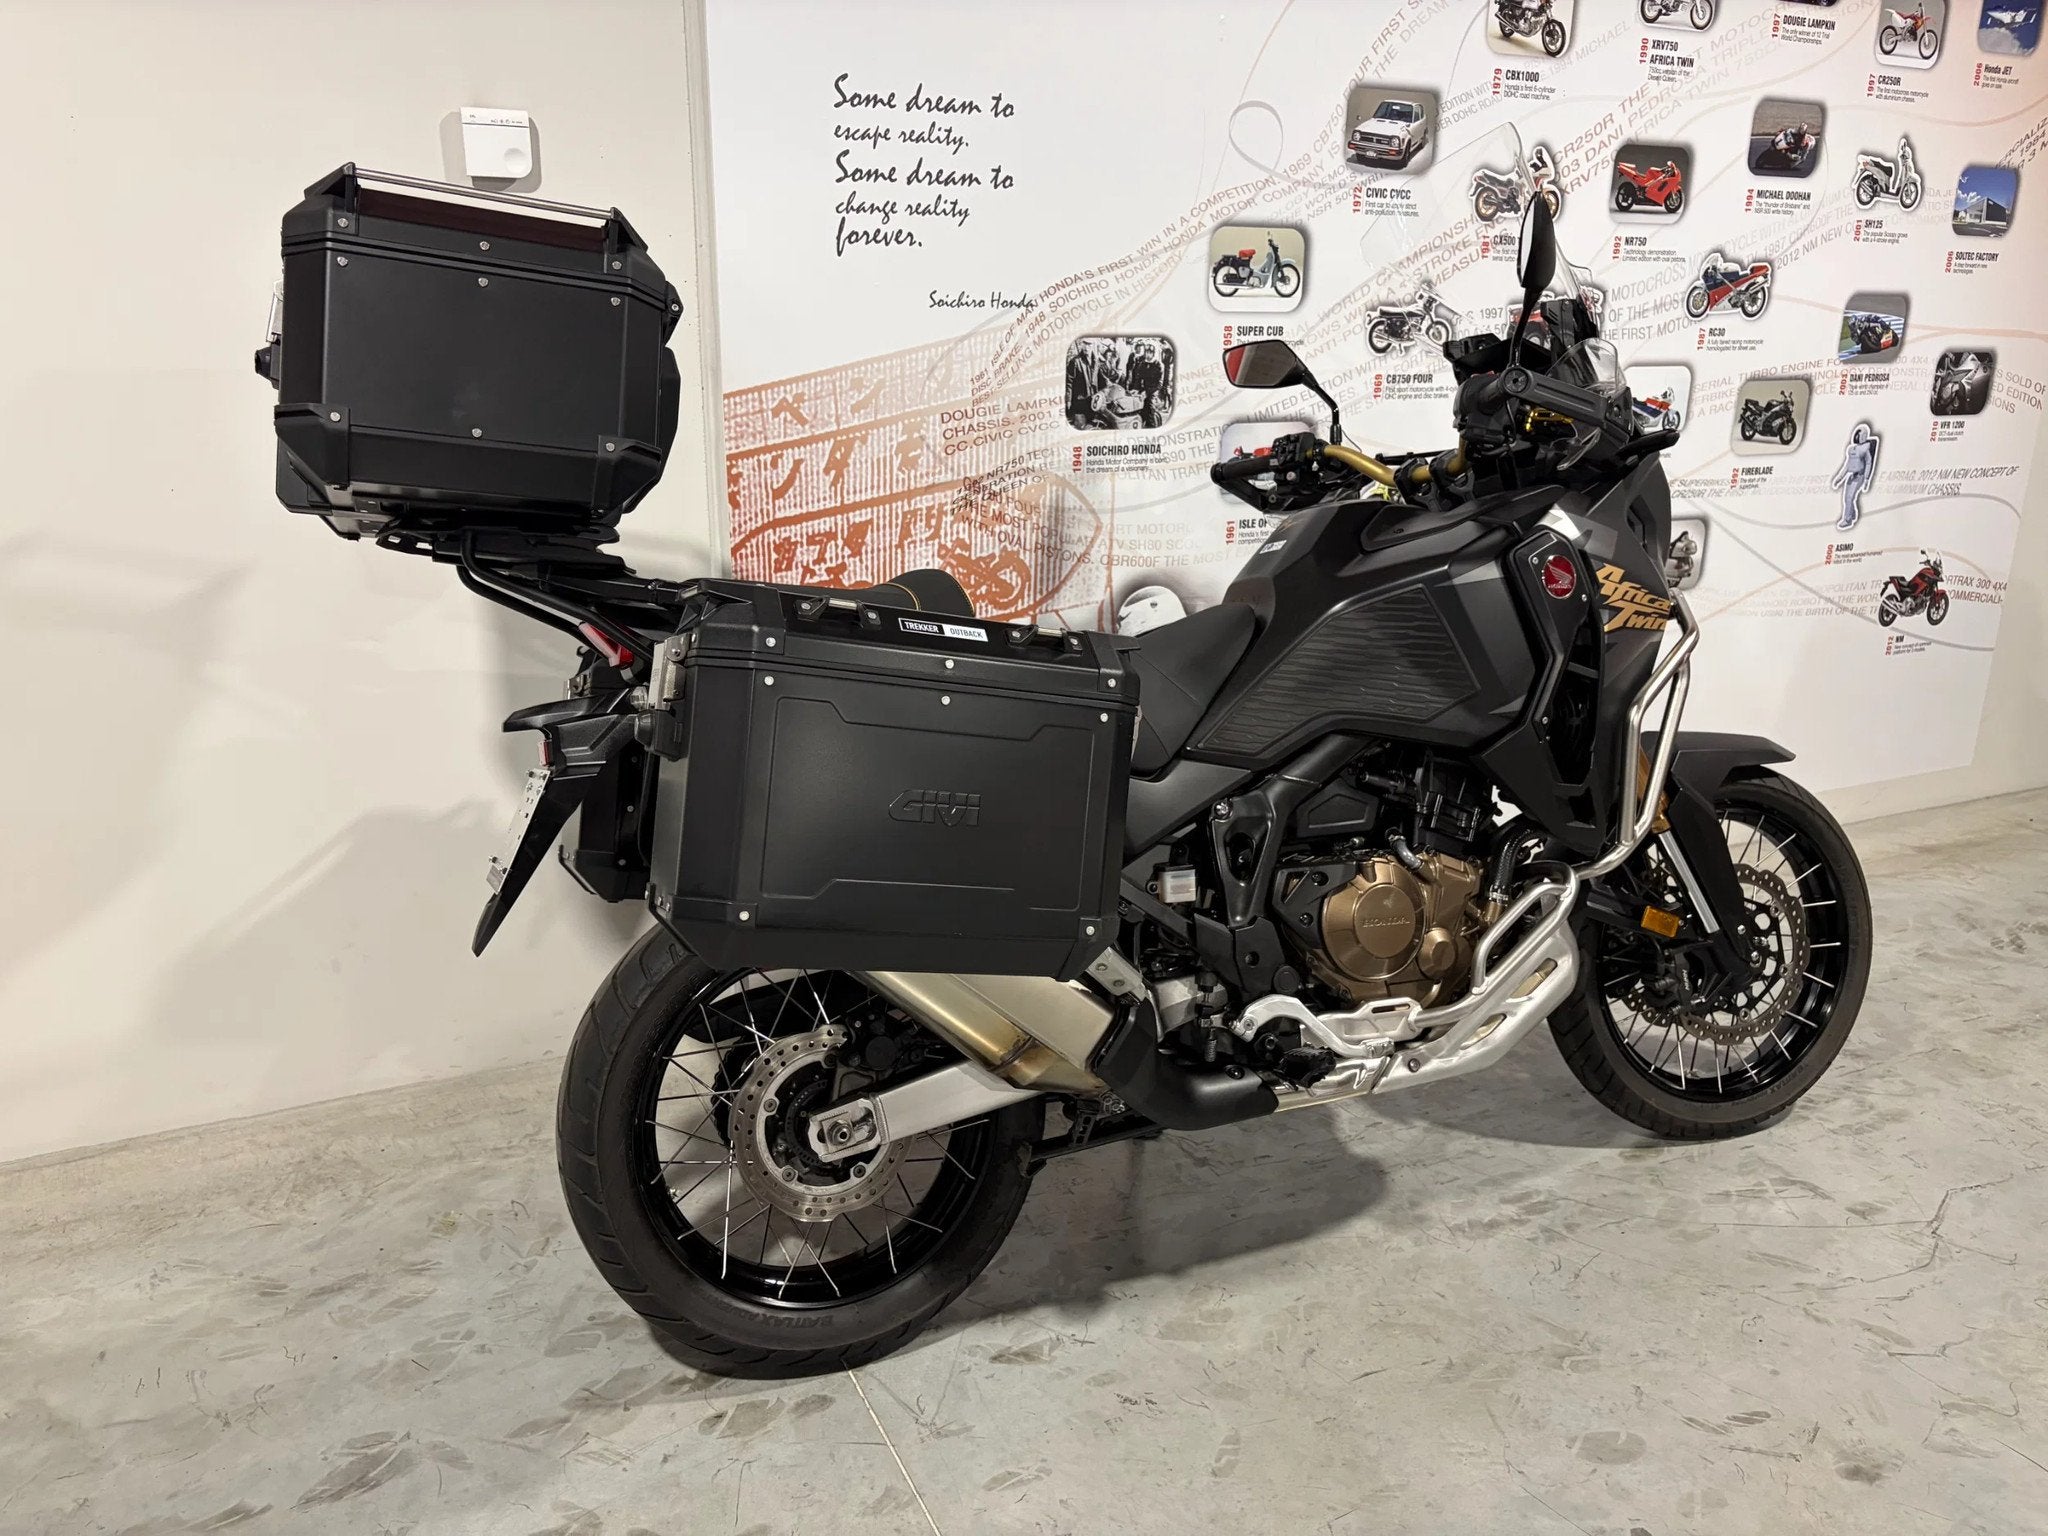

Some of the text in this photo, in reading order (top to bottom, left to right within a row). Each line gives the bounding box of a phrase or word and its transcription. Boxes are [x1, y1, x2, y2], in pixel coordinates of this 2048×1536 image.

[1772, 13, 1780, 38] 1997
[1783, 15, 1836, 30] DOUGIE LAMPKIN
[1576, 20, 1630, 60] MICHAEL
[1651, 39, 1679, 52] XRV750
[1639, 38, 1649, 64] 1990
[1650, 54, 1694, 68] AFRICA TWIN
[1372, 44, 1400, 81] THE
[1984, 64, 2012, 75] Honda JET
[1492, 68, 1502, 95] 1979
[1506, 70, 1539, 82] CBX1000
[1878, 75, 1901, 86] CR250R
[1974, 63, 1982, 86] 2006
[834, 73, 1015, 118] Some dream to
[1867, 74, 1876, 97] 1997
[1440, 86, 1474, 114] EDITION
[1453, 103, 1478, 124] DOHC
[1552, 82, 1652, 165] CR250R THE
[834, 121, 969, 155] escape reality.
[1585, 124, 1624, 162] DANI
[835, 149, 1014, 189] Some dream to
[1005, 324, 1016, 344] OF
[1040, 270, 1095, 302] HONDA'S
[1097, 254, 1134, 276] FIRST
[1136, 235, 1162, 256] WIN
[1163, 223, 1177, 238] IN
[1180, 216, 1189, 227] A
[1190, 175, 1281, 218] COMPETITION.
[1283, 153, 1312, 179] 1969
[1313, 104, 1344, 154] CB750
[1372, 8, 1407, 55] FIRST
[1352, 186, 1362, 213] 1972
[1366, 187, 1388, 199] CIVIC
[1745, 189, 1754, 212] 1994
[1757, 190, 1811, 200] MICHAEL DOOHAN
[835, 191, 970, 227] change reality
[1854, 220, 1862, 241] 2001
[1864, 220, 1883, 228] SH125
[836, 216, 923, 257] forever.
[1624, 236, 1647, 246] NR750
[1482, 236, 1490, 259] 1981
[1612, 236, 1621, 260] 1992
[1777, 249, 1800, 270] 2012
[1820, 226, 1844, 244] NEW
[1955, 251, 1999, 262] SOLTEC FACTORY
[1945, 251, 1954, 273] 2006
[971, 377, 992, 396] DISC
[1025, 311, 1046, 338] 1948
[1050, 279, 1109, 313] SOICHIRO
[1115, 252, 1160, 284] HONDA
[1164, 220, 1207, 253] HONDA
[1210, 197, 1258, 222] MOTOR
[1262, 160, 1326, 203] COMPANY
[1612, 264, 1686, 302] MOTOCROSS
[929, 290, 1035, 309] Soichiro Honda
[1033, 293, 1115, 351] MOTORCYCLE
[1115, 286, 1131, 300] IN
[1480, 308, 1504, 319] 1997
[1608, 308, 1626, 322] OF
[1628, 303, 1649, 318] THE
[1223, 326, 1233, 350] 958
[1237, 326, 1284, 336] SUPER CUB
[1622, 326, 1654, 340] FIRST
[1697, 328, 1706, 350] 1987
[1708, 328, 1726, 337] RC30
[1386, 374, 1433, 384] CB750 FOUR
[1738, 366, 1778, 381] TURBO
[1781, 358, 1824, 373] ENGINE
[1850, 373, 1890, 382] DANI PEDROSA
[2006, 370, 2032, 388] SOLD
[1373, 374, 1382, 399] 1969
[941, 404, 1002, 424] DOUGIE
[1246, 394, 1300, 422] LIMITED
[942, 410, 1052, 440] CHASSIS. 2001
[1018, 420, 1060, 436] CVCC
[1930, 421, 1938, 442] 2010
[1940, 421, 1951, 429] VFR
[1072, 446, 1082, 473] 1948
[1086, 444, 1161, 457] SOICHIRO HONDA
[1188, 442, 1217, 458] THE
[986, 456, 1024, 480] NR750
[1123, 458, 1148, 466] Company
[1741, 466, 1773, 476] FIREBLADE
[1952, 466, 1972, 479] NEW
[1970, 466, 2008, 478] CONCEPT
[2006, 466, 2020, 476] OF
[1730, 468, 1739, 489] 1992
[1226, 521, 1235, 545] 1961
[1239, 519, 1256, 529] ISLE
[998, 531, 1031, 552] OVAL
[1034, 542, 1094, 565] PISTONS.
[1100, 554, 1161, 568] CBR600F
[1165, 556, 1189, 567] THE
[1128, 539, 1162, 551] SH80
[1825, 544, 1834, 565] 2000
[1836, 543, 1854, 552] ASIMO
[1596, 563, 1671, 611] Africa
[1975, 578, 1992, 590] 300
[1992, 581, 2008, 592] 4X4
[1603, 600, 1670, 632] Twin
[1806, 607, 1832, 617] BIRTH
[904, 622, 984, 639] TREKKER OUTBACK
[888, 789, 981, 827] GIVI
